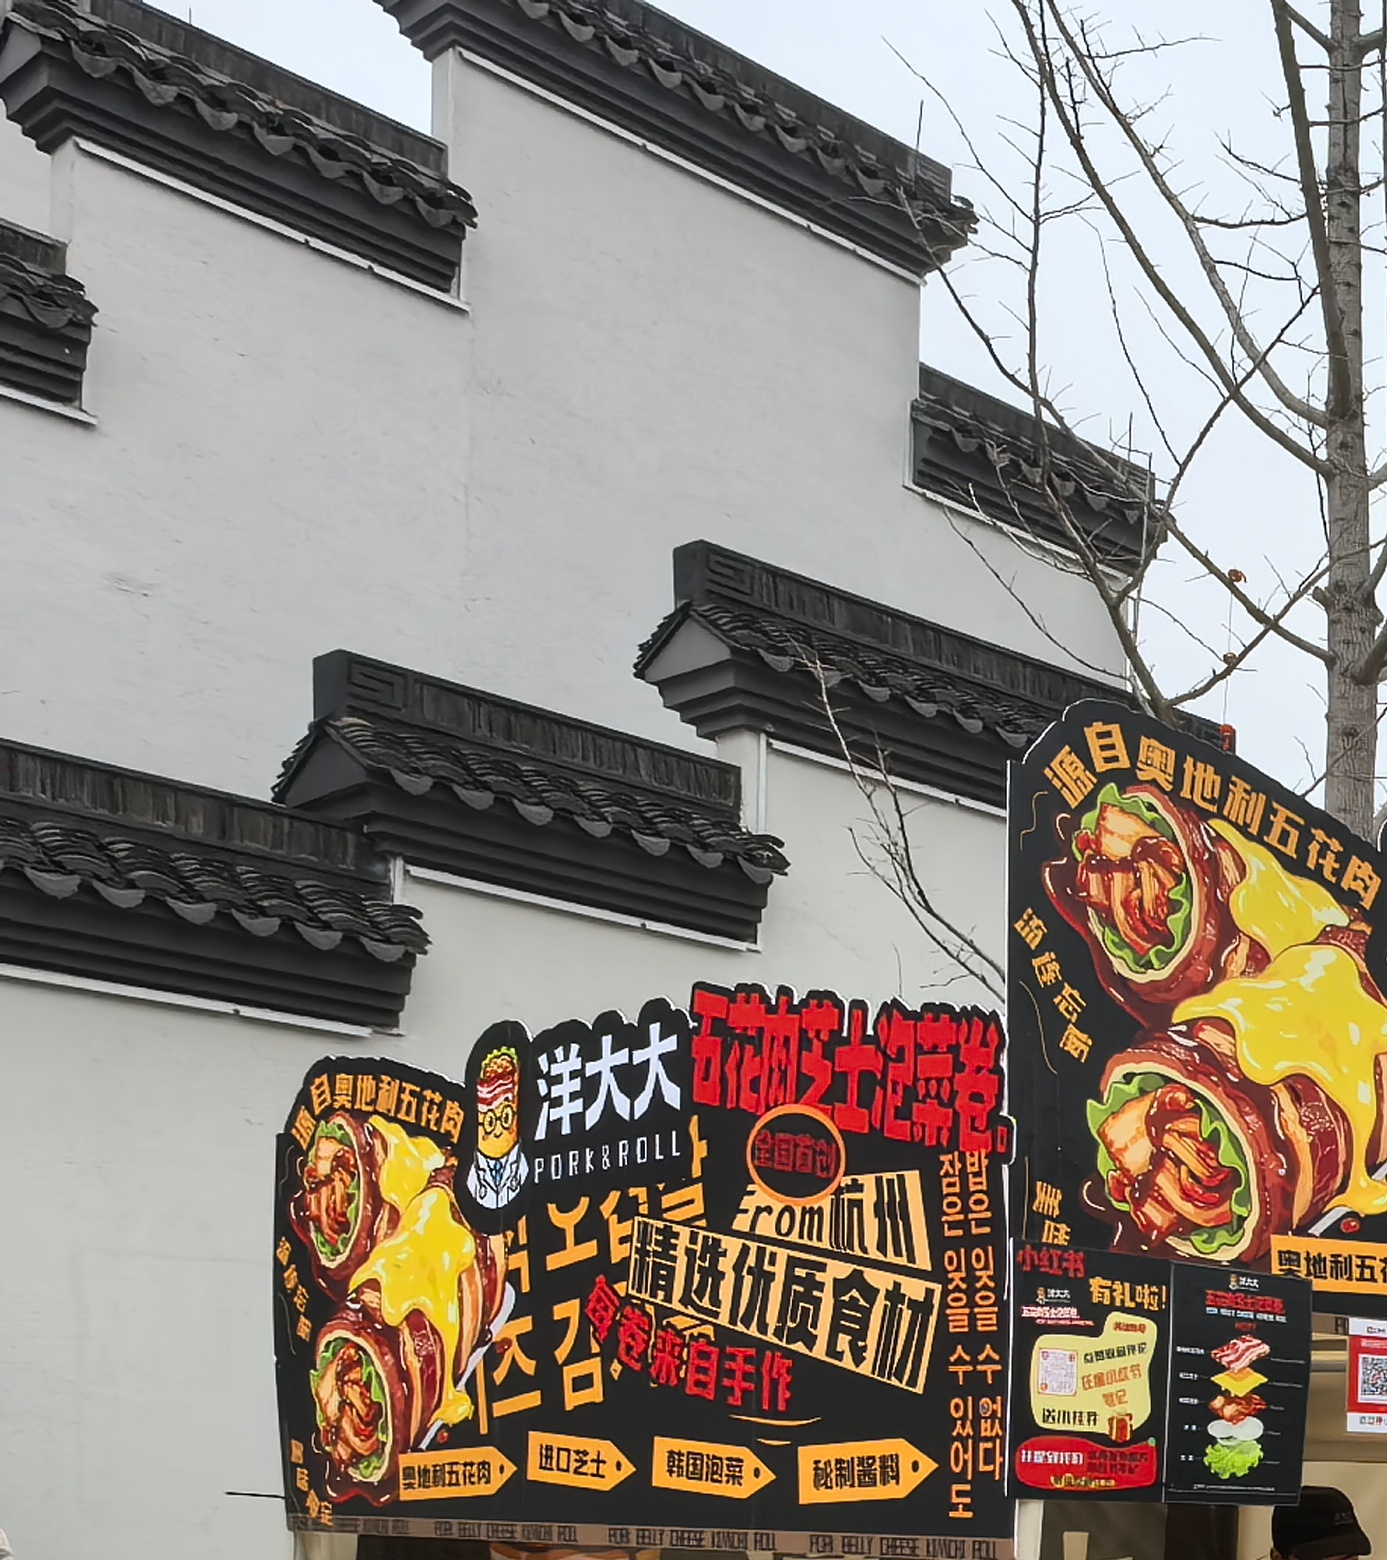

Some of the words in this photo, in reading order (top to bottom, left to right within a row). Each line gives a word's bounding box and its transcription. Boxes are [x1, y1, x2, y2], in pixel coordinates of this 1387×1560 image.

[1042, 722, 1382, 911] 源自奥地利五花肉
[291, 1073, 464, 1150] 源自奥地利五花肉
[534, 1021, 682, 1142] 洋大大
[534, 1130, 681, 1183] PORK&ROLL
[939, 1151, 965, 1238] 잠은
[965, 1149, 993, 1237] 밥은
[944, 1248, 972, 1333] 잊을
[971, 1246, 998, 1332] 잊을
[1017, 1244, 1086, 1278] 小红书
[586, 1274, 793, 1412] 每卷来自手作
[634, 1220, 938, 1390] 精选优质食材
[948, 1343, 973, 1385] 수
[976, 1343, 1002, 1385] 수
[401, 1458, 493, 1491] 奥地利五花肉
[538, 1443, 606, 1480] 进口芝士
[666, 1450, 745, 1487] 韩国泡菜
[813, 1455, 900, 1489] 秘制酱料
[949, 1395, 974, 1519] 있어도
[978, 1396, 1003, 1480] 없다
